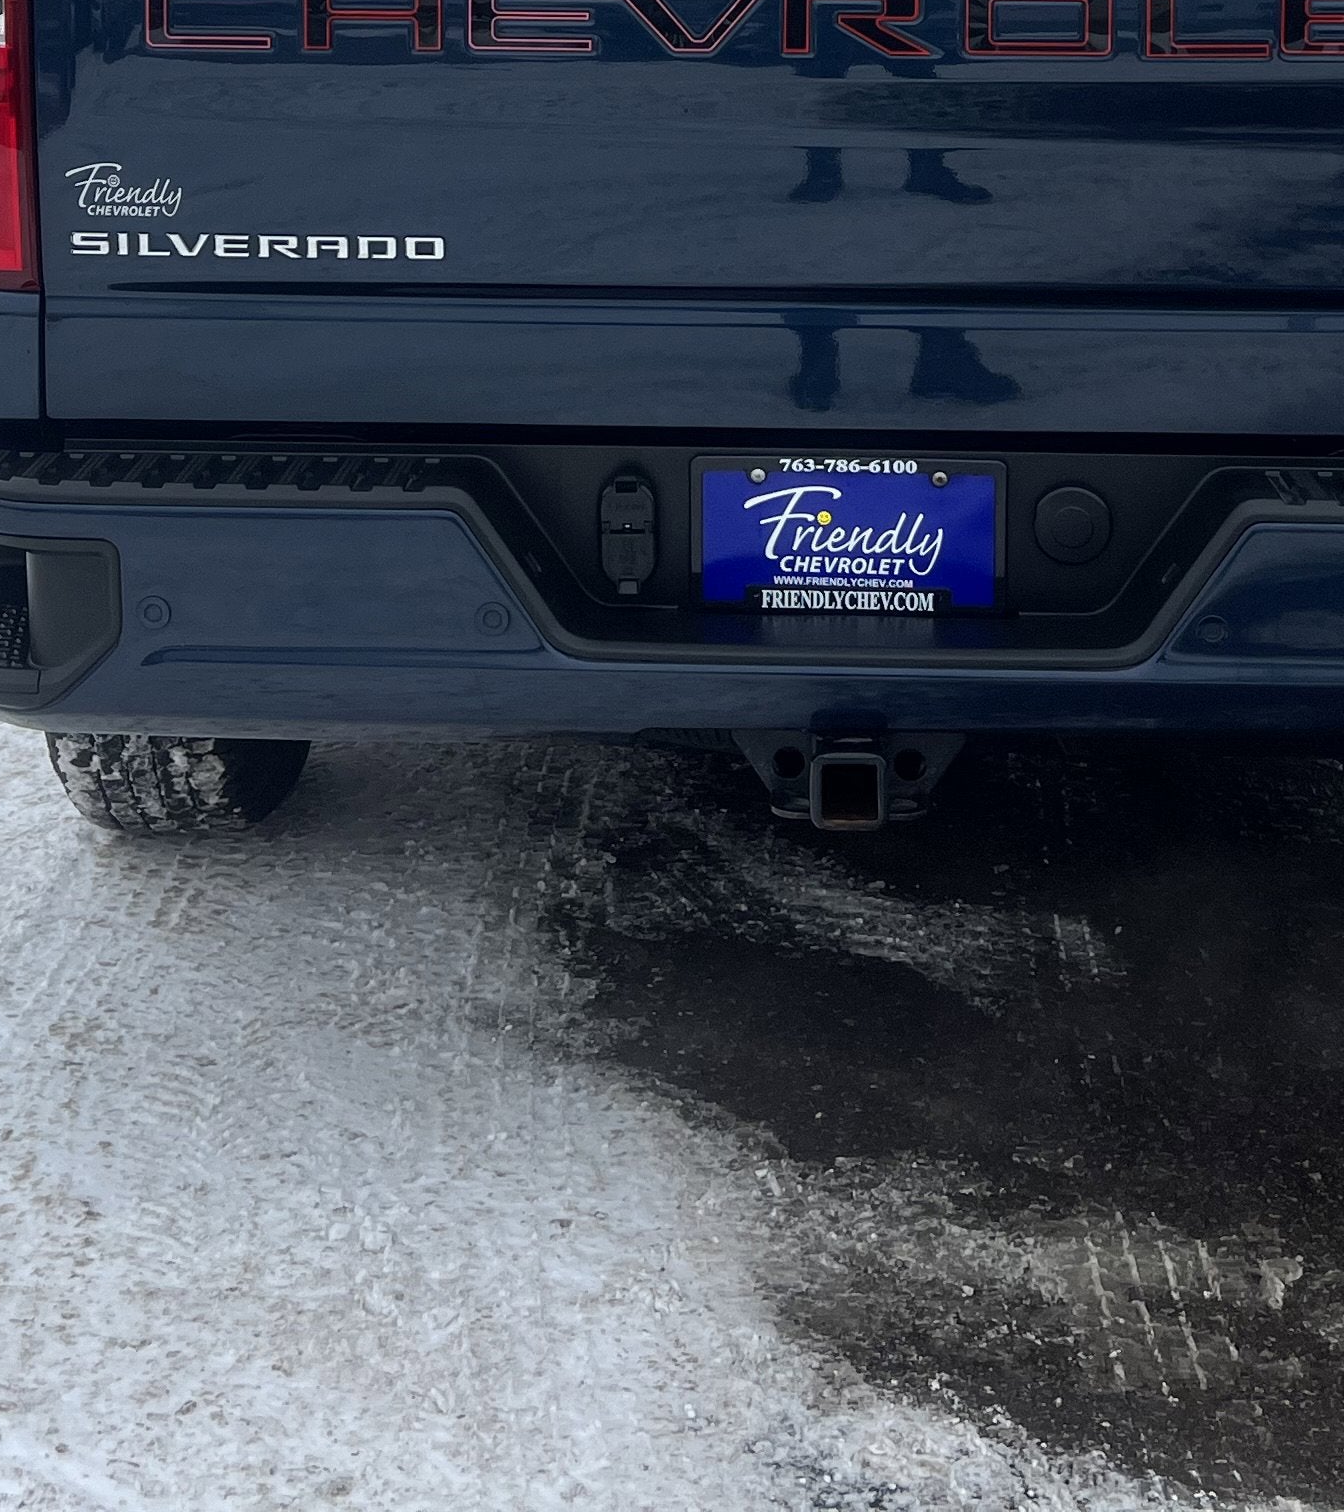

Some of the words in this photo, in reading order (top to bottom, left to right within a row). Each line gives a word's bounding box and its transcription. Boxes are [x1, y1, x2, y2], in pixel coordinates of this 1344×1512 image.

[65, 162, 182, 217] Friendly
[87, 204, 160, 217] CHEVROLET
[71, 231, 445, 259] SILVERADO
[779, 458, 917, 474] 763-786-6100
[743, 485, 943, 576] Friendly
[779, 555, 905, 575] CHEVROLET
[773, 575, 913, 588] WWW.FRIENDLYCHEV.COM
[761, 589, 934, 612] FRIENDLYCHEV.COM
